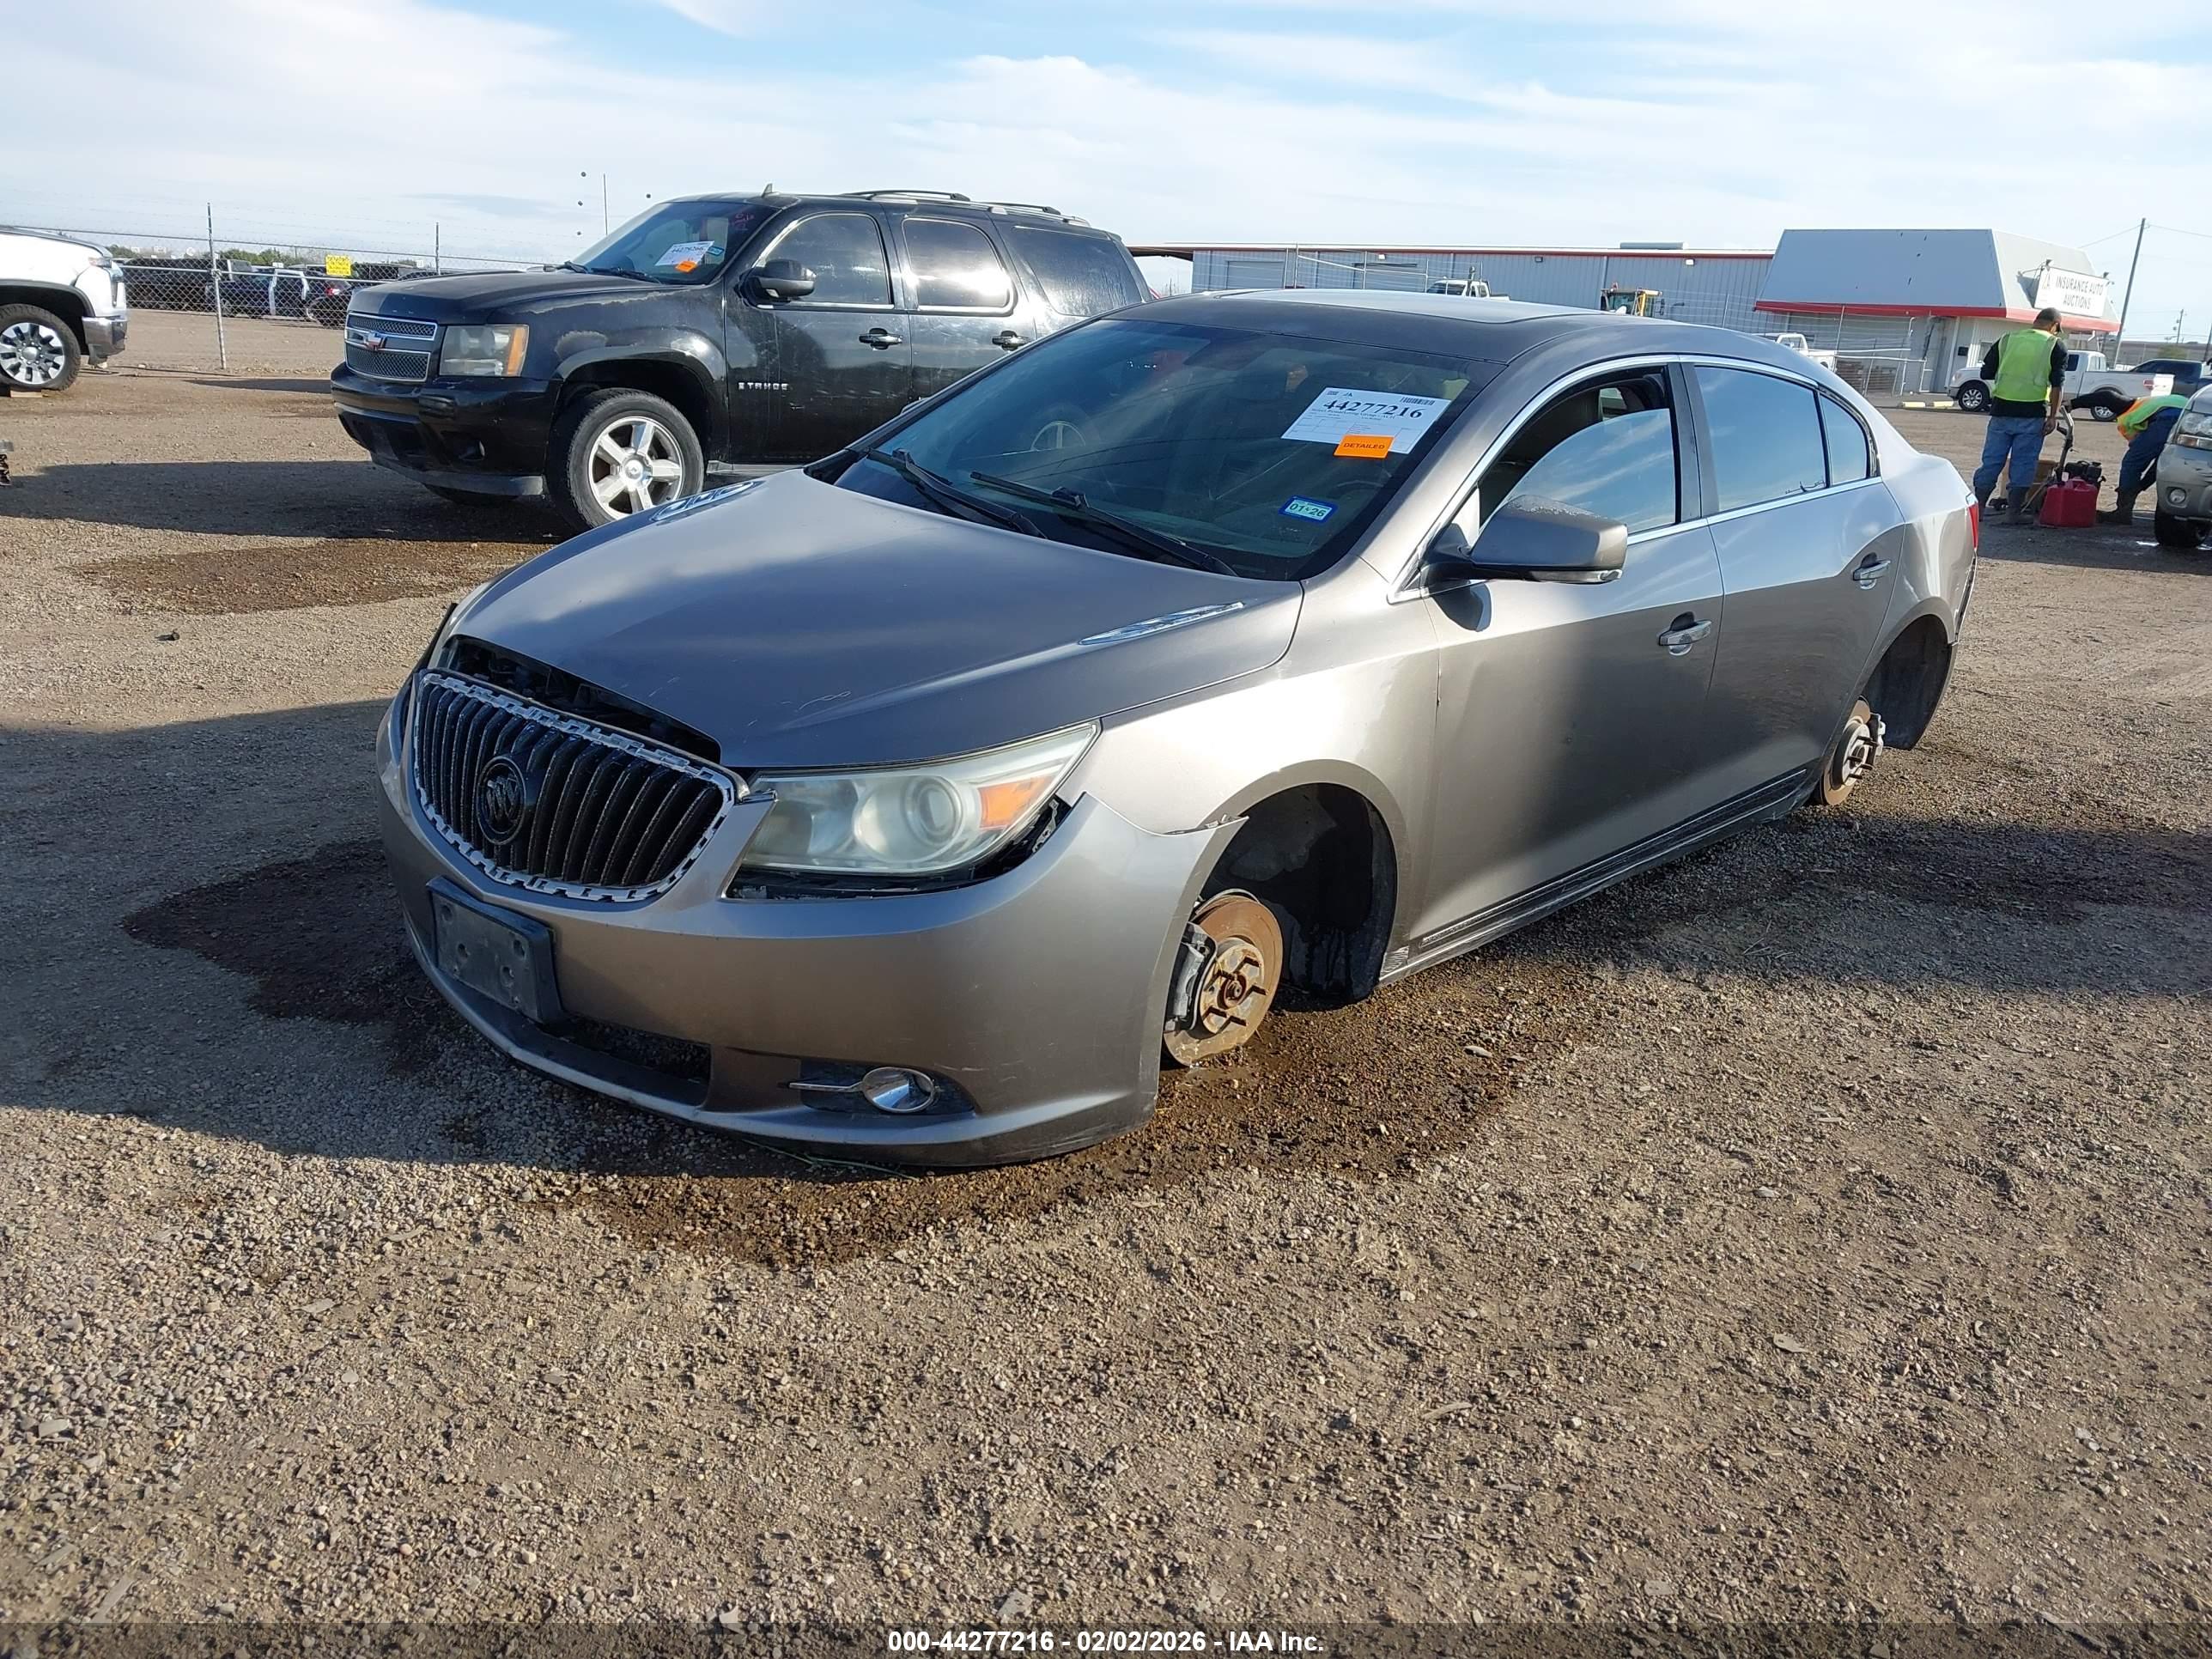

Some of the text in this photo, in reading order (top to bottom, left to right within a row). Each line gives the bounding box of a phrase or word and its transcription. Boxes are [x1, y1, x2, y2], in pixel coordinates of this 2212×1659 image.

[2056, 276, 2089, 294] INSURANCE
[2088, 282, 2104, 296] AUTO
[2063, 294, 2091, 309] AUCTIONS
[747, 382, 788, 391] TAHOE
[1323, 399, 1424, 419] 44277216
